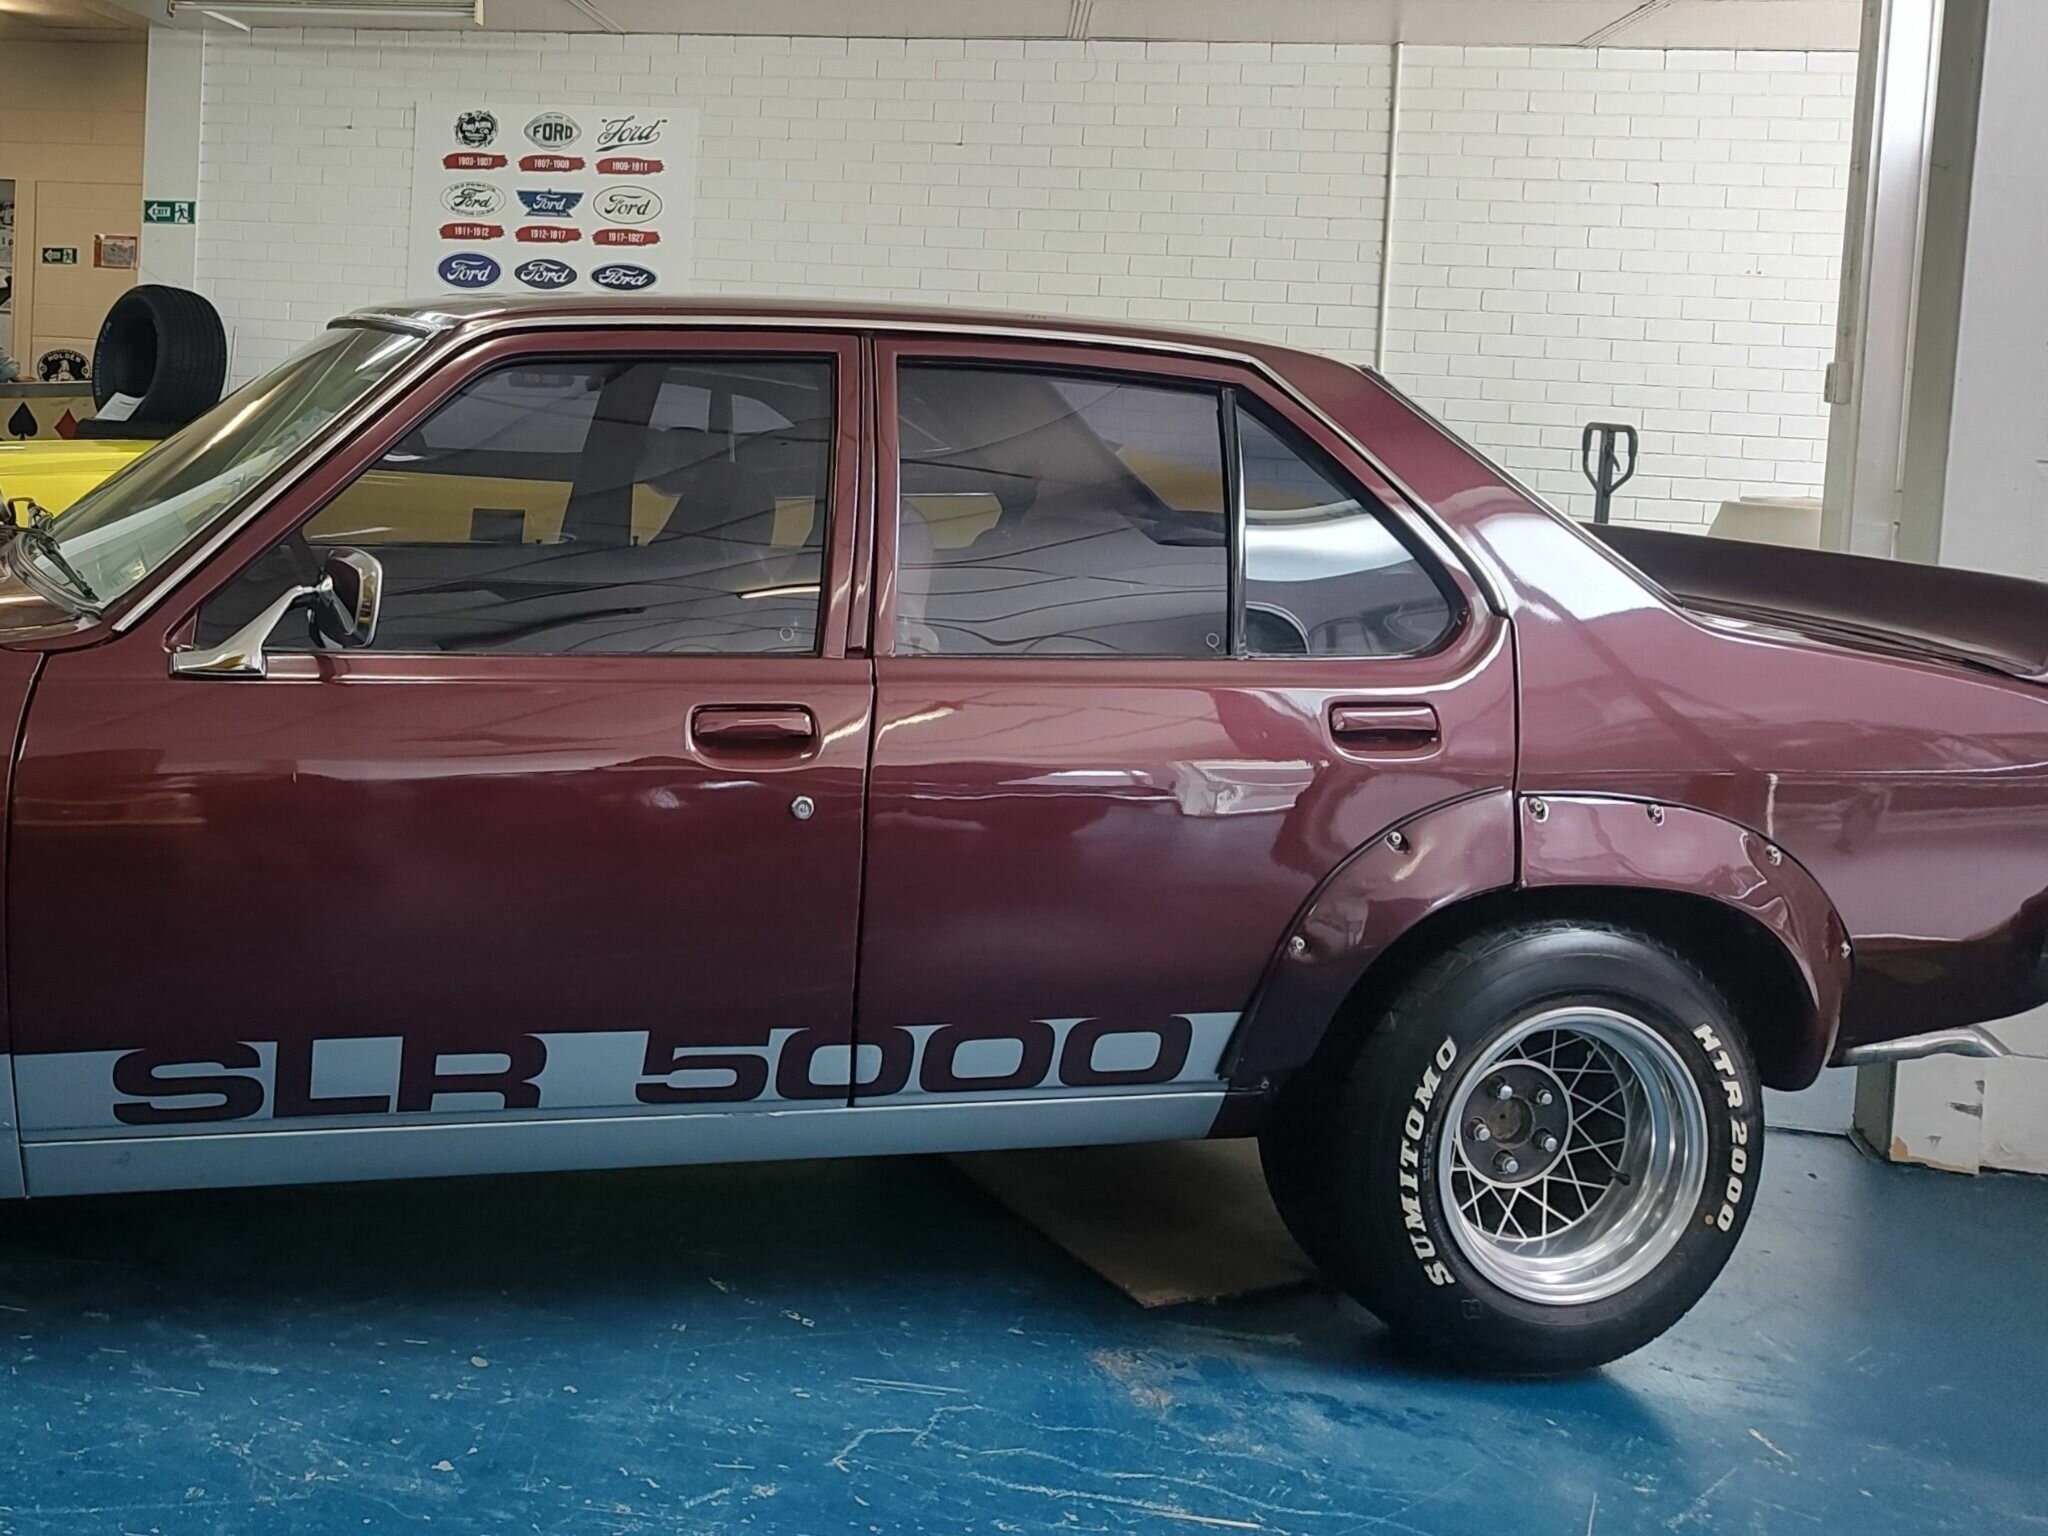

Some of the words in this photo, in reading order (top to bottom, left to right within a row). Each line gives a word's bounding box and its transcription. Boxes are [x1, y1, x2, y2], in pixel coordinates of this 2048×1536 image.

[533, 122, 573, 141] FORD
[452, 187, 493, 208] Ford
[532, 193, 567, 210] Ford
[604, 193, 651, 215] Ford
[152, 207, 169, 216] EXIT
[608, 232, 645, 243] 1917-1927
[447, 258, 493, 282] Ford
[520, 261, 570, 283] Ford
[598, 266, 648, 286] Ford
[48, 353, 81, 363] HOLDEN
[112, 1032, 548, 1125] SLR
[635, 1014, 1193, 1104] 5000
[1692, 1023, 1744, 1110] HTR
[1398, 1036, 1459, 1287] SUMITOMO
[1716, 1118, 1748, 1233] 2000
